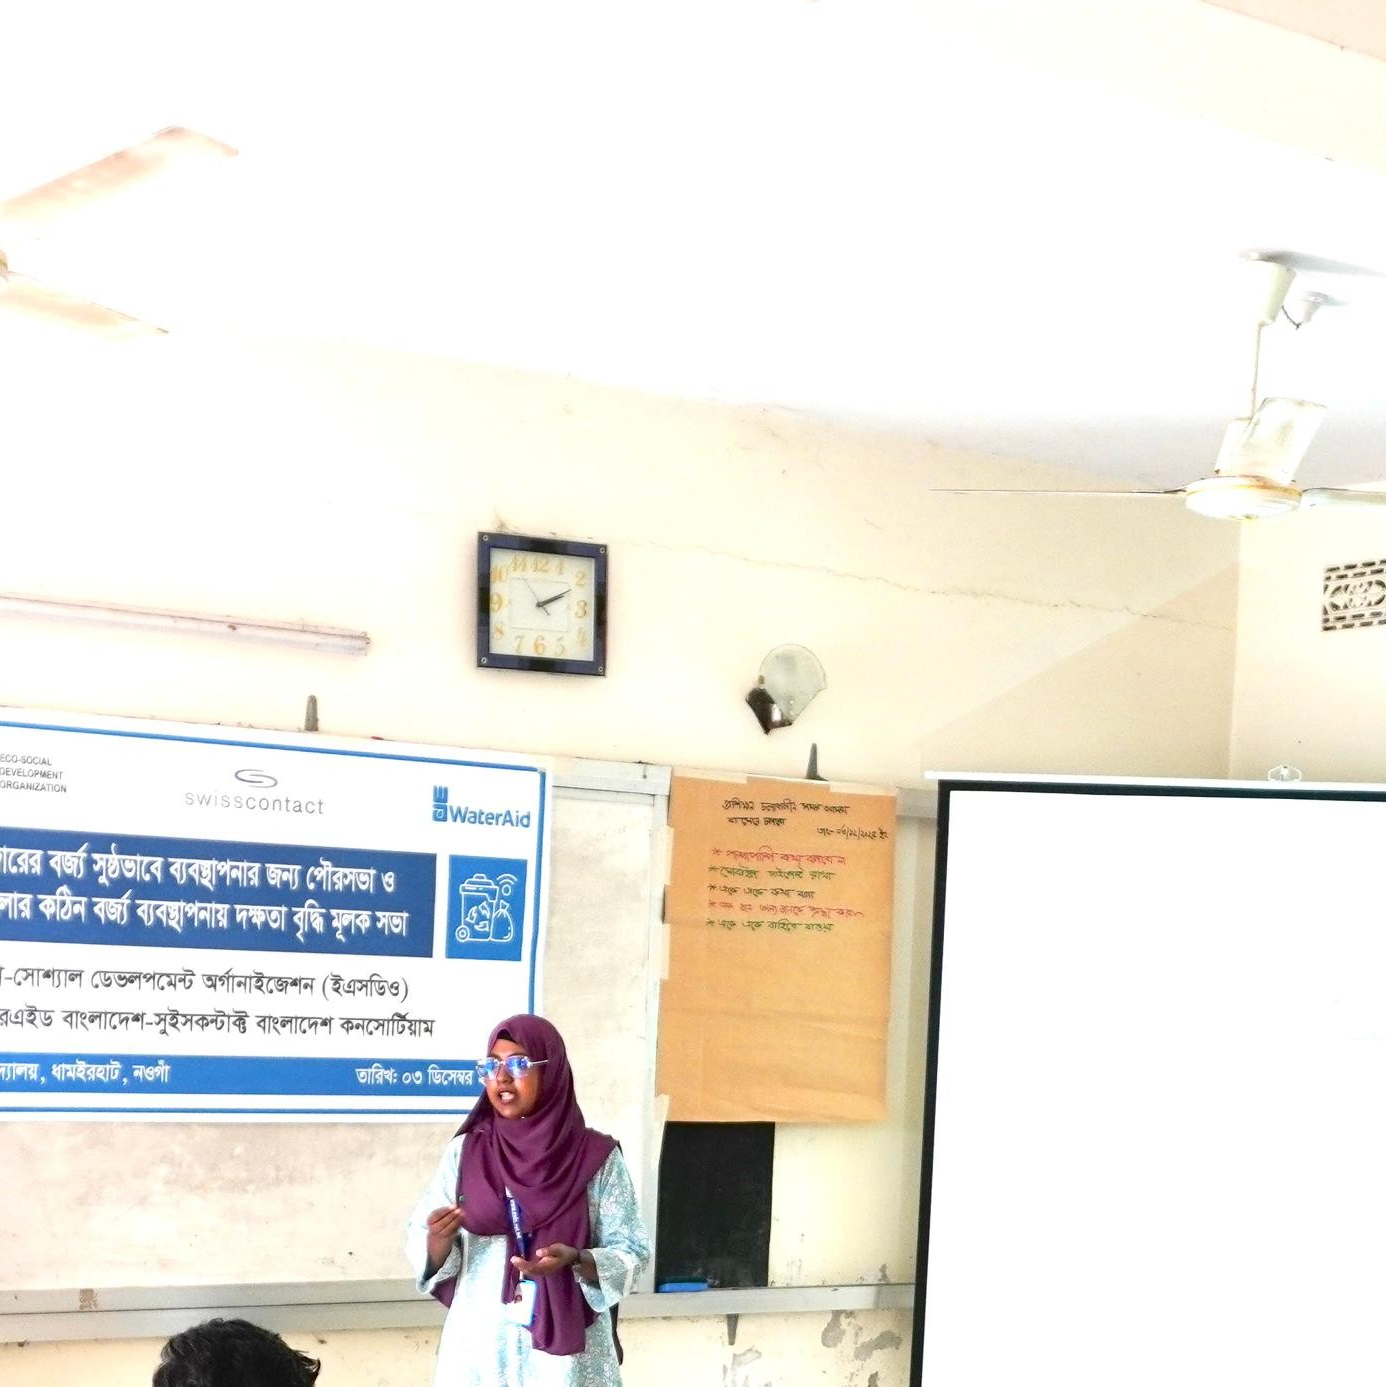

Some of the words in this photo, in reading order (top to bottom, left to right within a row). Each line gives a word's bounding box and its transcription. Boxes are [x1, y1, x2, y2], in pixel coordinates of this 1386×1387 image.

[575, 571, 587, 587] 2
[574, 599, 588, 618] 3
[533, 635, 547, 655] 6
[0, 753, 52, 766] ECO-SOCIAL
[0, 767, 63, 780] DEVELOPMENT
[0, 780, 67, 793] ORGANIZATION
[184, 790, 325, 815] swisscontact
[448, 805, 531, 828] WaterAid
[48, 842, 91, 879] বর্জ্য
[168, 857, 261, 891] ব্যবস্থাপনার
[266, 861, 302, 890] জন্য
[306, 857, 377, 893] পৌরসভা
[382, 870, 395, 893] ও
[37, 885, 88, 923] কঠিন
[92, 889, 133, 925] বর্জ্য
[135, 898, 230, 933] ব্যবস্থাপনায়
[234, 903, 288, 931] দক্ষতা
[292, 899, 327, 943] বৃদ্ধি
[331, 909, 372, 942] মূলক
[376, 910, 409, 937] সভা
[91, 967, 196, 991] ডেভলপমেন্ট
[202, 967, 315, 996] অর্গানাইজেশন
[322, 973, 410, 1003] (ইএসডিও)
[256, 1014, 332, 1037] বাংলাদেশ
[339, 1012, 435, 1038] কনসোর্টিয়াম
[133, 1060, 171, 1084] নওগাঁ
[356, 1063, 397, 1087] তারিখ:
[402, 1070, 422, 1085] ০৩
[427, 1064, 474, 1086] ডিসেম্বর
